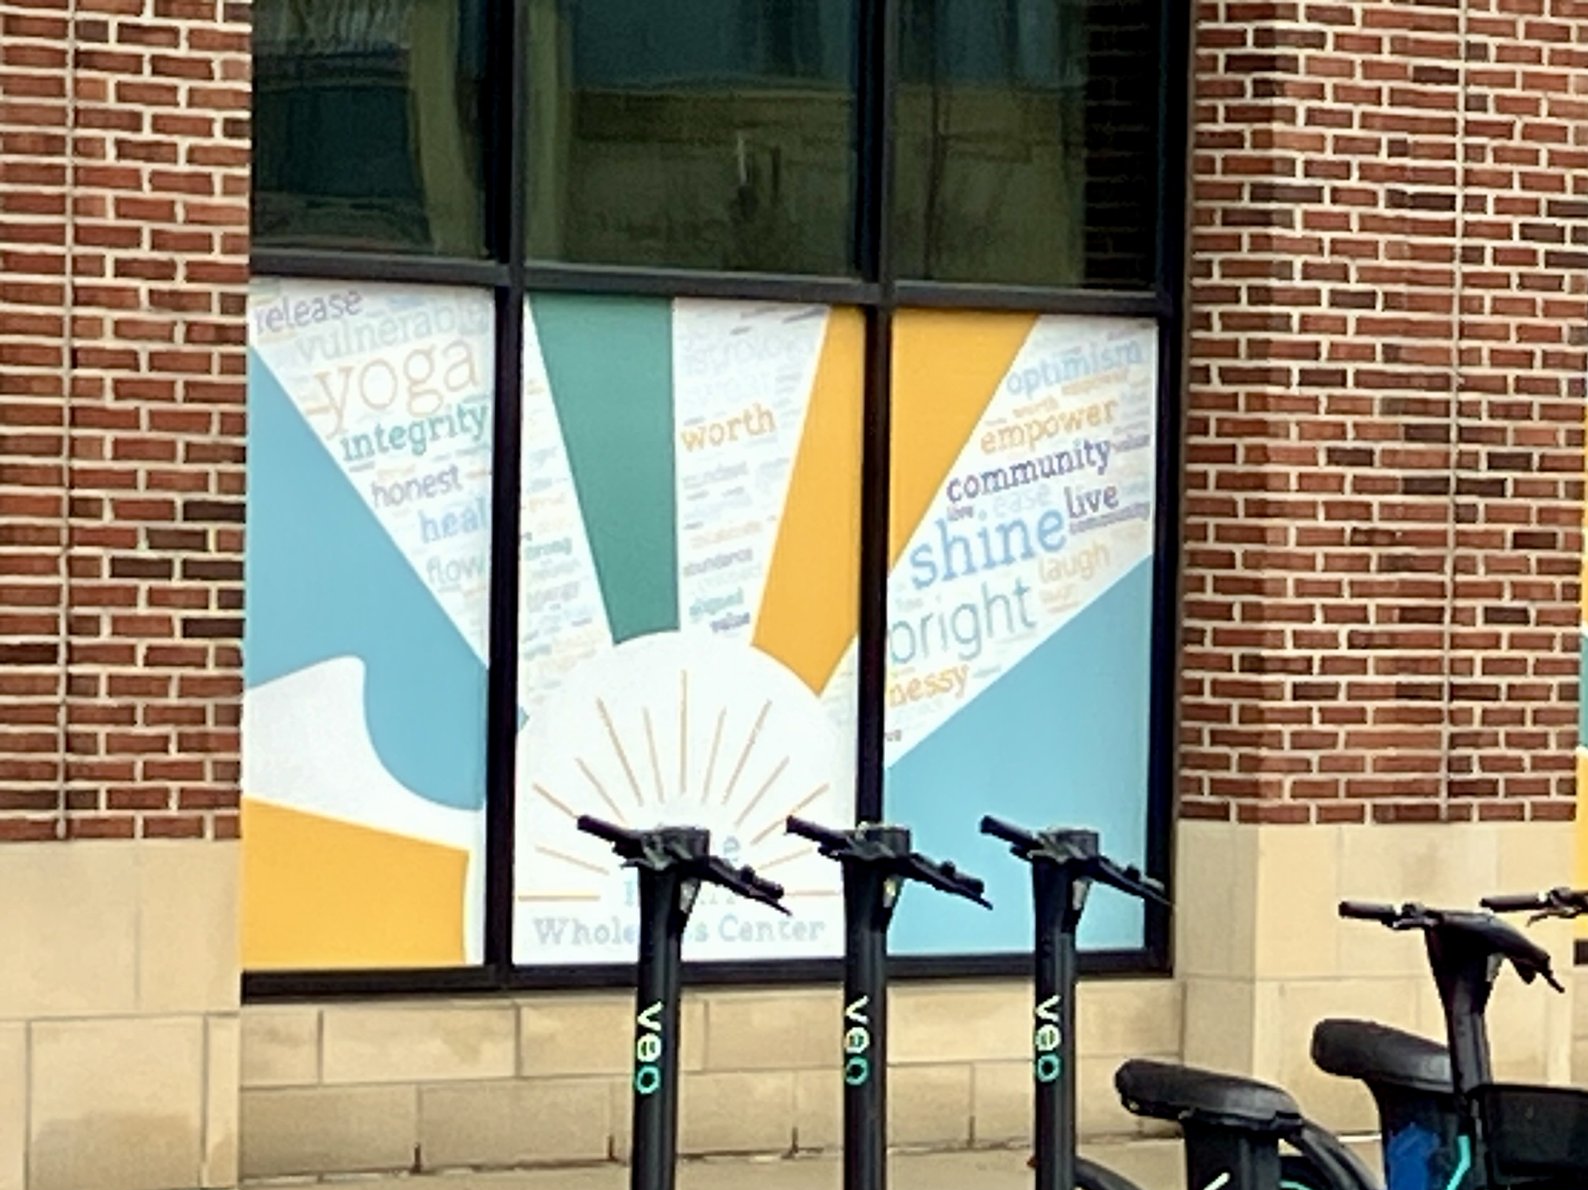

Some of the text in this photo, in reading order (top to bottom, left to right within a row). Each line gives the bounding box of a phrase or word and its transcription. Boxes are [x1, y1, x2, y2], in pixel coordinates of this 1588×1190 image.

[314, 339, 480, 440] yoga
[1006, 340, 1142, 400] optimism
[341, 404, 488, 463] integrity
[681, 403, 775, 452] worth
[980, 400, 1118, 455] empower
[372, 465, 463, 508] honest
[946, 438, 1111, 504] community
[1064, 485, 1119, 518] live
[909, 509, 1066, 590] shine
[1038, 542, 1110, 583] laugh
[533, 914, 827, 946] Wholes Center
[637, 1001, 663, 1094] veo
[844, 995, 870, 1085] veo
[1036, 995, 1061, 1082] veo
